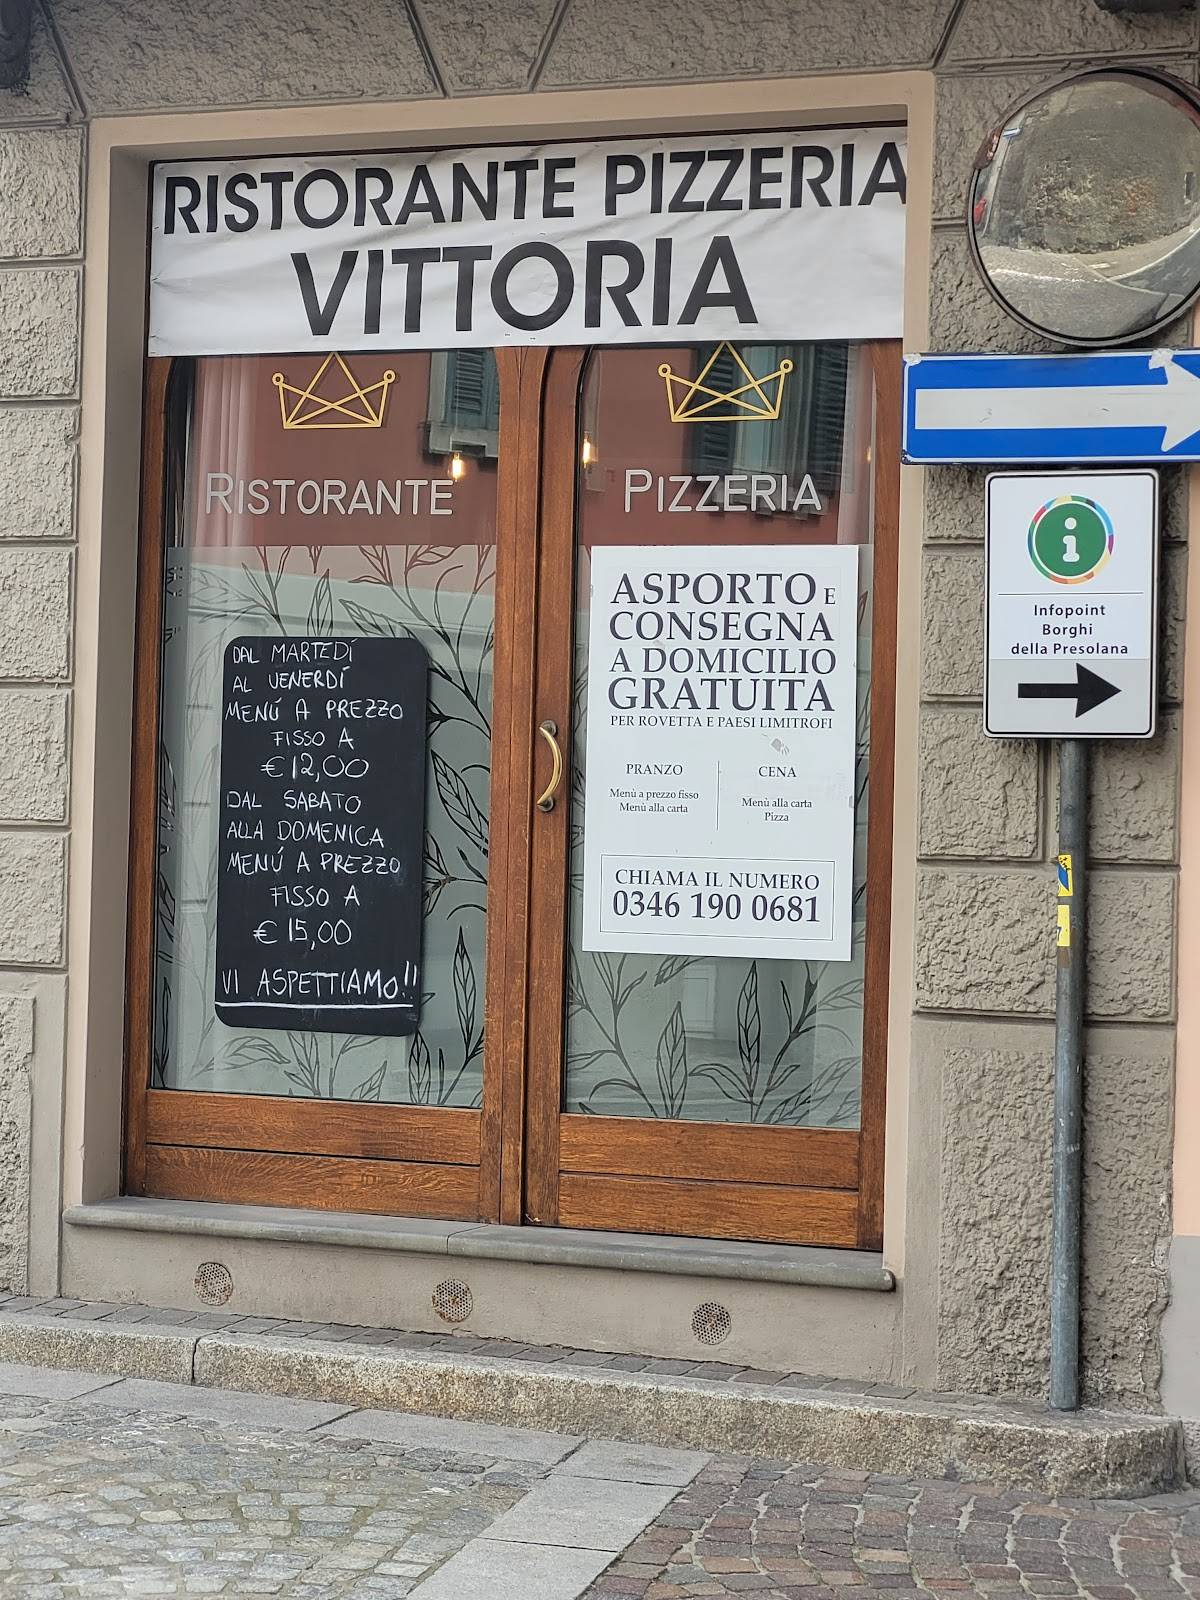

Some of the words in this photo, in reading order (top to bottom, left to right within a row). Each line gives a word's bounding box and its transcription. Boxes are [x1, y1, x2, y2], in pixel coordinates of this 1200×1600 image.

[163, 157, 576, 234] RISTORANTE
[604, 141, 906, 216] PIZZERIA
[291, 235, 758, 336] VITTORIA
[206, 472, 454, 515] RISTORANTE
[624, 468, 822, 514] PIZZERIA
[610, 572, 817, 605] ASPORTO
[823, 587, 837, 605] E
[1033, 604, 1106, 618] Infopoint
[609, 611, 835, 642] CONSEGNA
[1042, 623, 1093, 637] Borghi
[232, 646, 260, 664] DAL
[1011, 642, 1048, 655] della
[1053, 642, 1128, 655] Presolana
[609, 647, 632, 673] A
[642, 647, 837, 675] DOMICILIO
[232, 675, 252, 693] AL
[607, 677, 836, 712] GRATUITA
[295, 698, 311, 722] A
[326, 698, 404, 720] PREZZO
[610, 715, 635, 727] PER
[638, 715, 702, 728] ROVETTA
[706, 717, 714, 728] E
[717, 717, 755, 729] PAESI
[759, 717, 833, 729] LIMITROFI
[270, 730, 326, 747] FISSO
[338, 727, 355, 750] A
[626, 764, 683, 776] PRANZO
[758, 766, 797, 778] CENA
[226, 790, 263, 810] DAL
[283, 789, 361, 814] SABATO
[610, 788, 637, 799] Menù
[646, 791, 676, 801] prezzo
[678, 789, 699, 800] fisso
[741, 797, 769, 808] Menù
[771, 798, 789, 808] alla
[790, 799, 812, 808] carta
[619, 802, 647, 813] Menù
[649, 803, 665, 812] alla
[667, 804, 688, 814] carta
[764, 811, 789, 822] Pizza
[226, 819, 264, 841] ALLA
[277, 820, 385, 848] DOMENICA
[297, 851, 311, 873] A
[320, 852, 401, 875] PREZZO
[615, 868, 699, 887] CHIAMA
[704, 871, 723, 888] IL
[728, 872, 820, 890] NUMERO
[269, 885, 330, 907] FISSO
[344, 885, 360, 906] A
[613, 890, 680, 918] 0346
[690, 892, 742, 920] 190
[751, 895, 820, 923] 0681
[222, 968, 239, 994] VI
